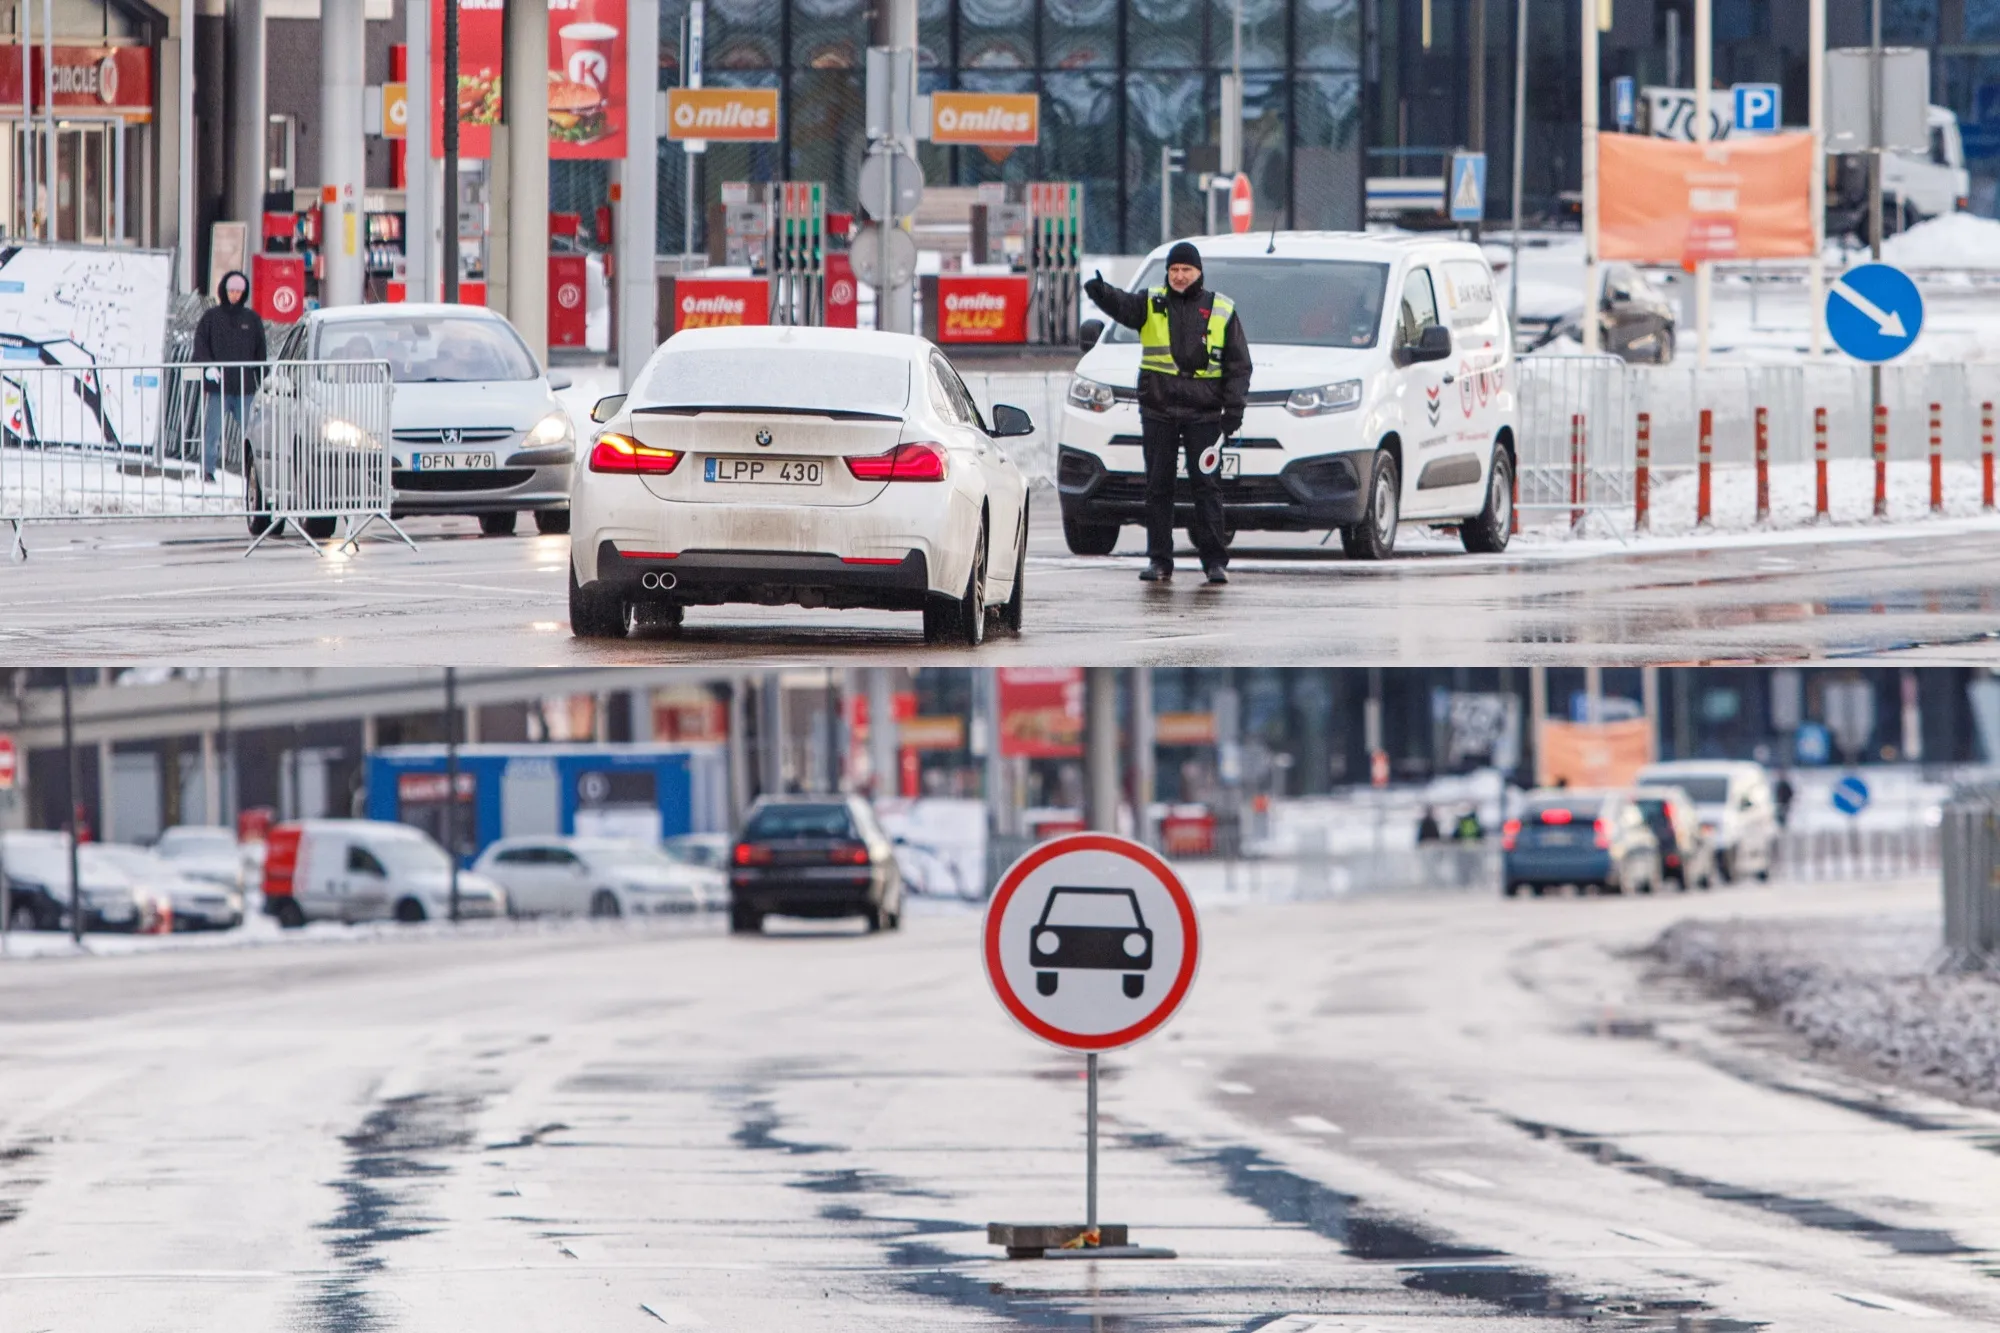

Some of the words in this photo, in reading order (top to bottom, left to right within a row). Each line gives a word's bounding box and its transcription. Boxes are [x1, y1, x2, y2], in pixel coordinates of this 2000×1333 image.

[51, 64, 98, 94] CIRCLE
[1743, 90, 1772, 128] P
[421, 454, 456, 469] DFN
[718, 460, 765, 480] LPP
[779, 462, 820, 482] 430
